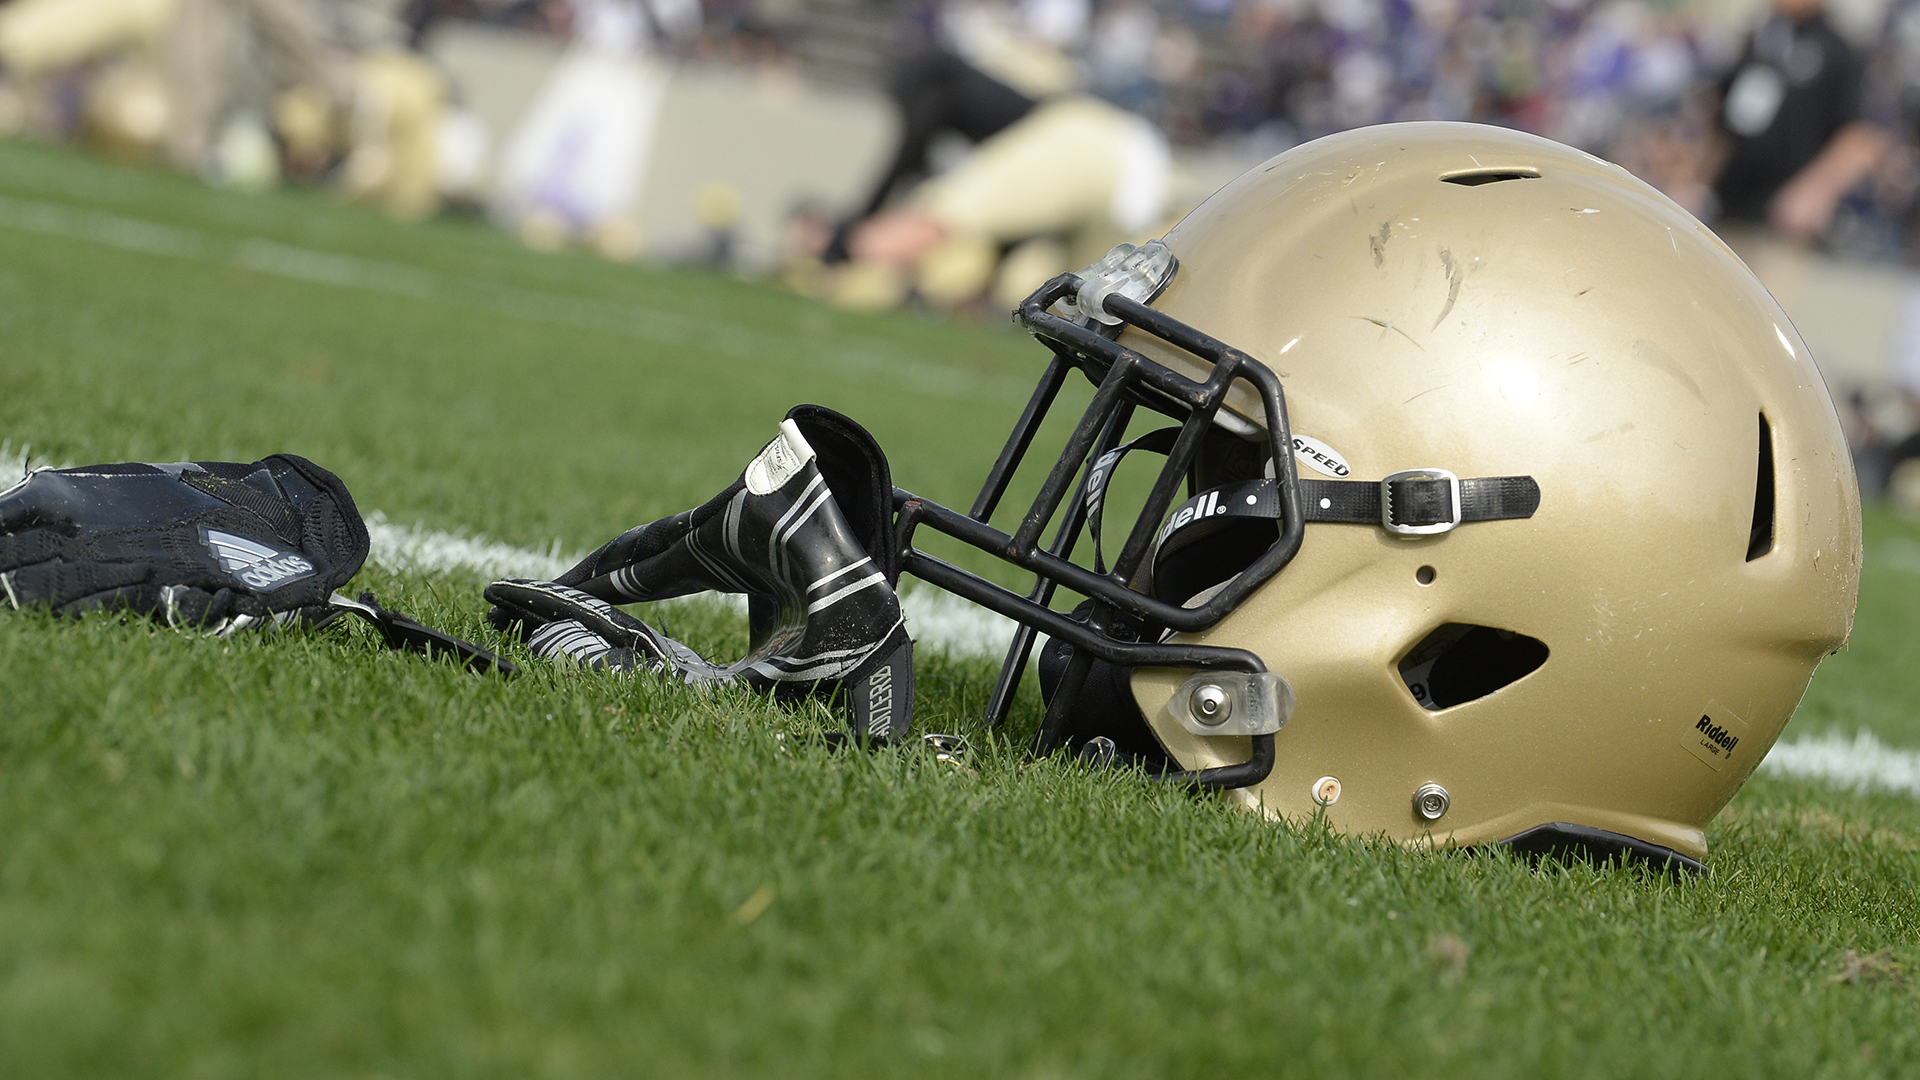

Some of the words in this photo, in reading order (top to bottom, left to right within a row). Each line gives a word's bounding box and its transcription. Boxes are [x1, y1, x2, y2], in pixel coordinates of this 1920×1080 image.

[1292, 438, 1349, 476] SPEED
[241, 555, 313, 587] adidas
[1695, 714, 1740, 752] Riddell
[1700, 738, 1720, 756] LARGE
